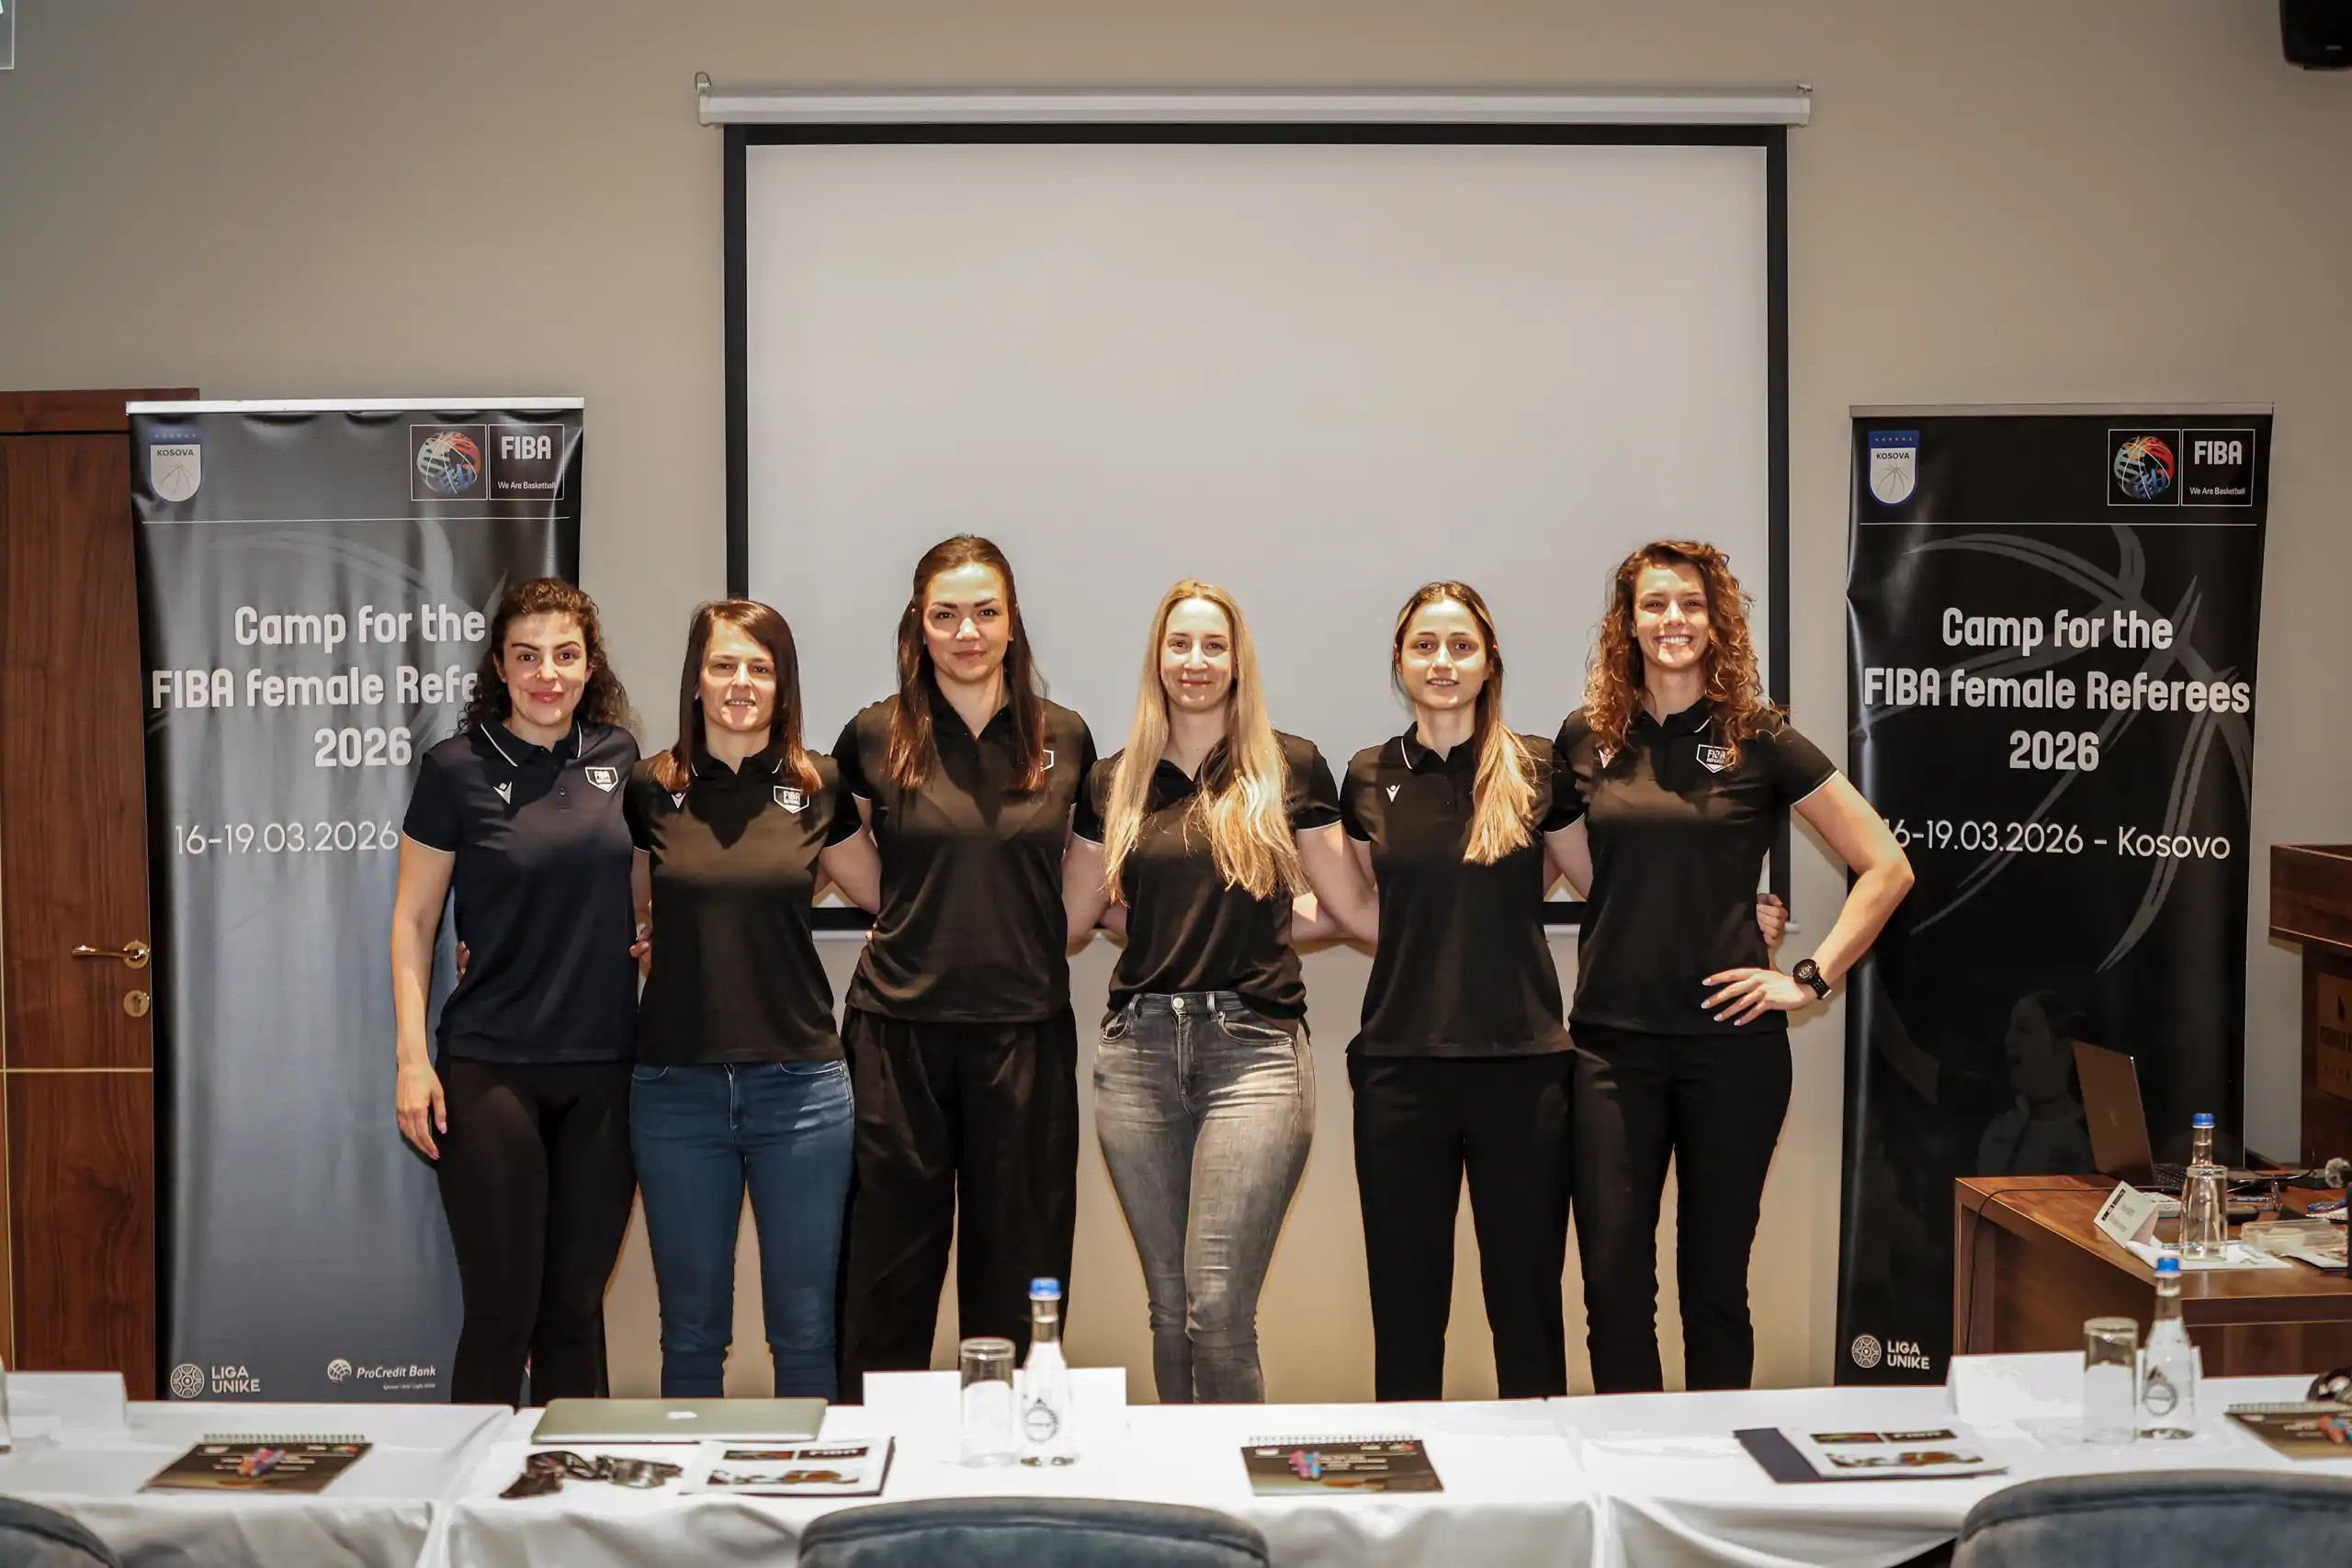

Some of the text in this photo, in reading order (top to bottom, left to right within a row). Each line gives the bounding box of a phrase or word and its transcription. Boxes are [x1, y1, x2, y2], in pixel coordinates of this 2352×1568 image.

[502, 435, 551, 459] FIBA
[2195, 441, 2242, 465] FIBA
[234, 604, 485, 653] Camp for the
[1942, 607, 2173, 656] Camp for the
[153, 665, 479, 708] FIBA female Refe
[1864, 667, 2250, 713] FIBA female Referees
[314, 727, 413, 767] 2026
[2009, 730, 2098, 772] 2026
[175, 820, 399, 855] 16-19.03.2026
[1883, 818, 2084, 854] 6-19.03.2026
[2118, 827, 2231, 860] Kosovo
[1887, 1340, 1920, 1355] LIGA
[1887, 1354, 1930, 1370] UNIKE
[211, 1366, 249, 1379] LIGA
[211, 1380, 261, 1393] UNIKE
[356, 1365, 436, 1379] ProCredit Bank
